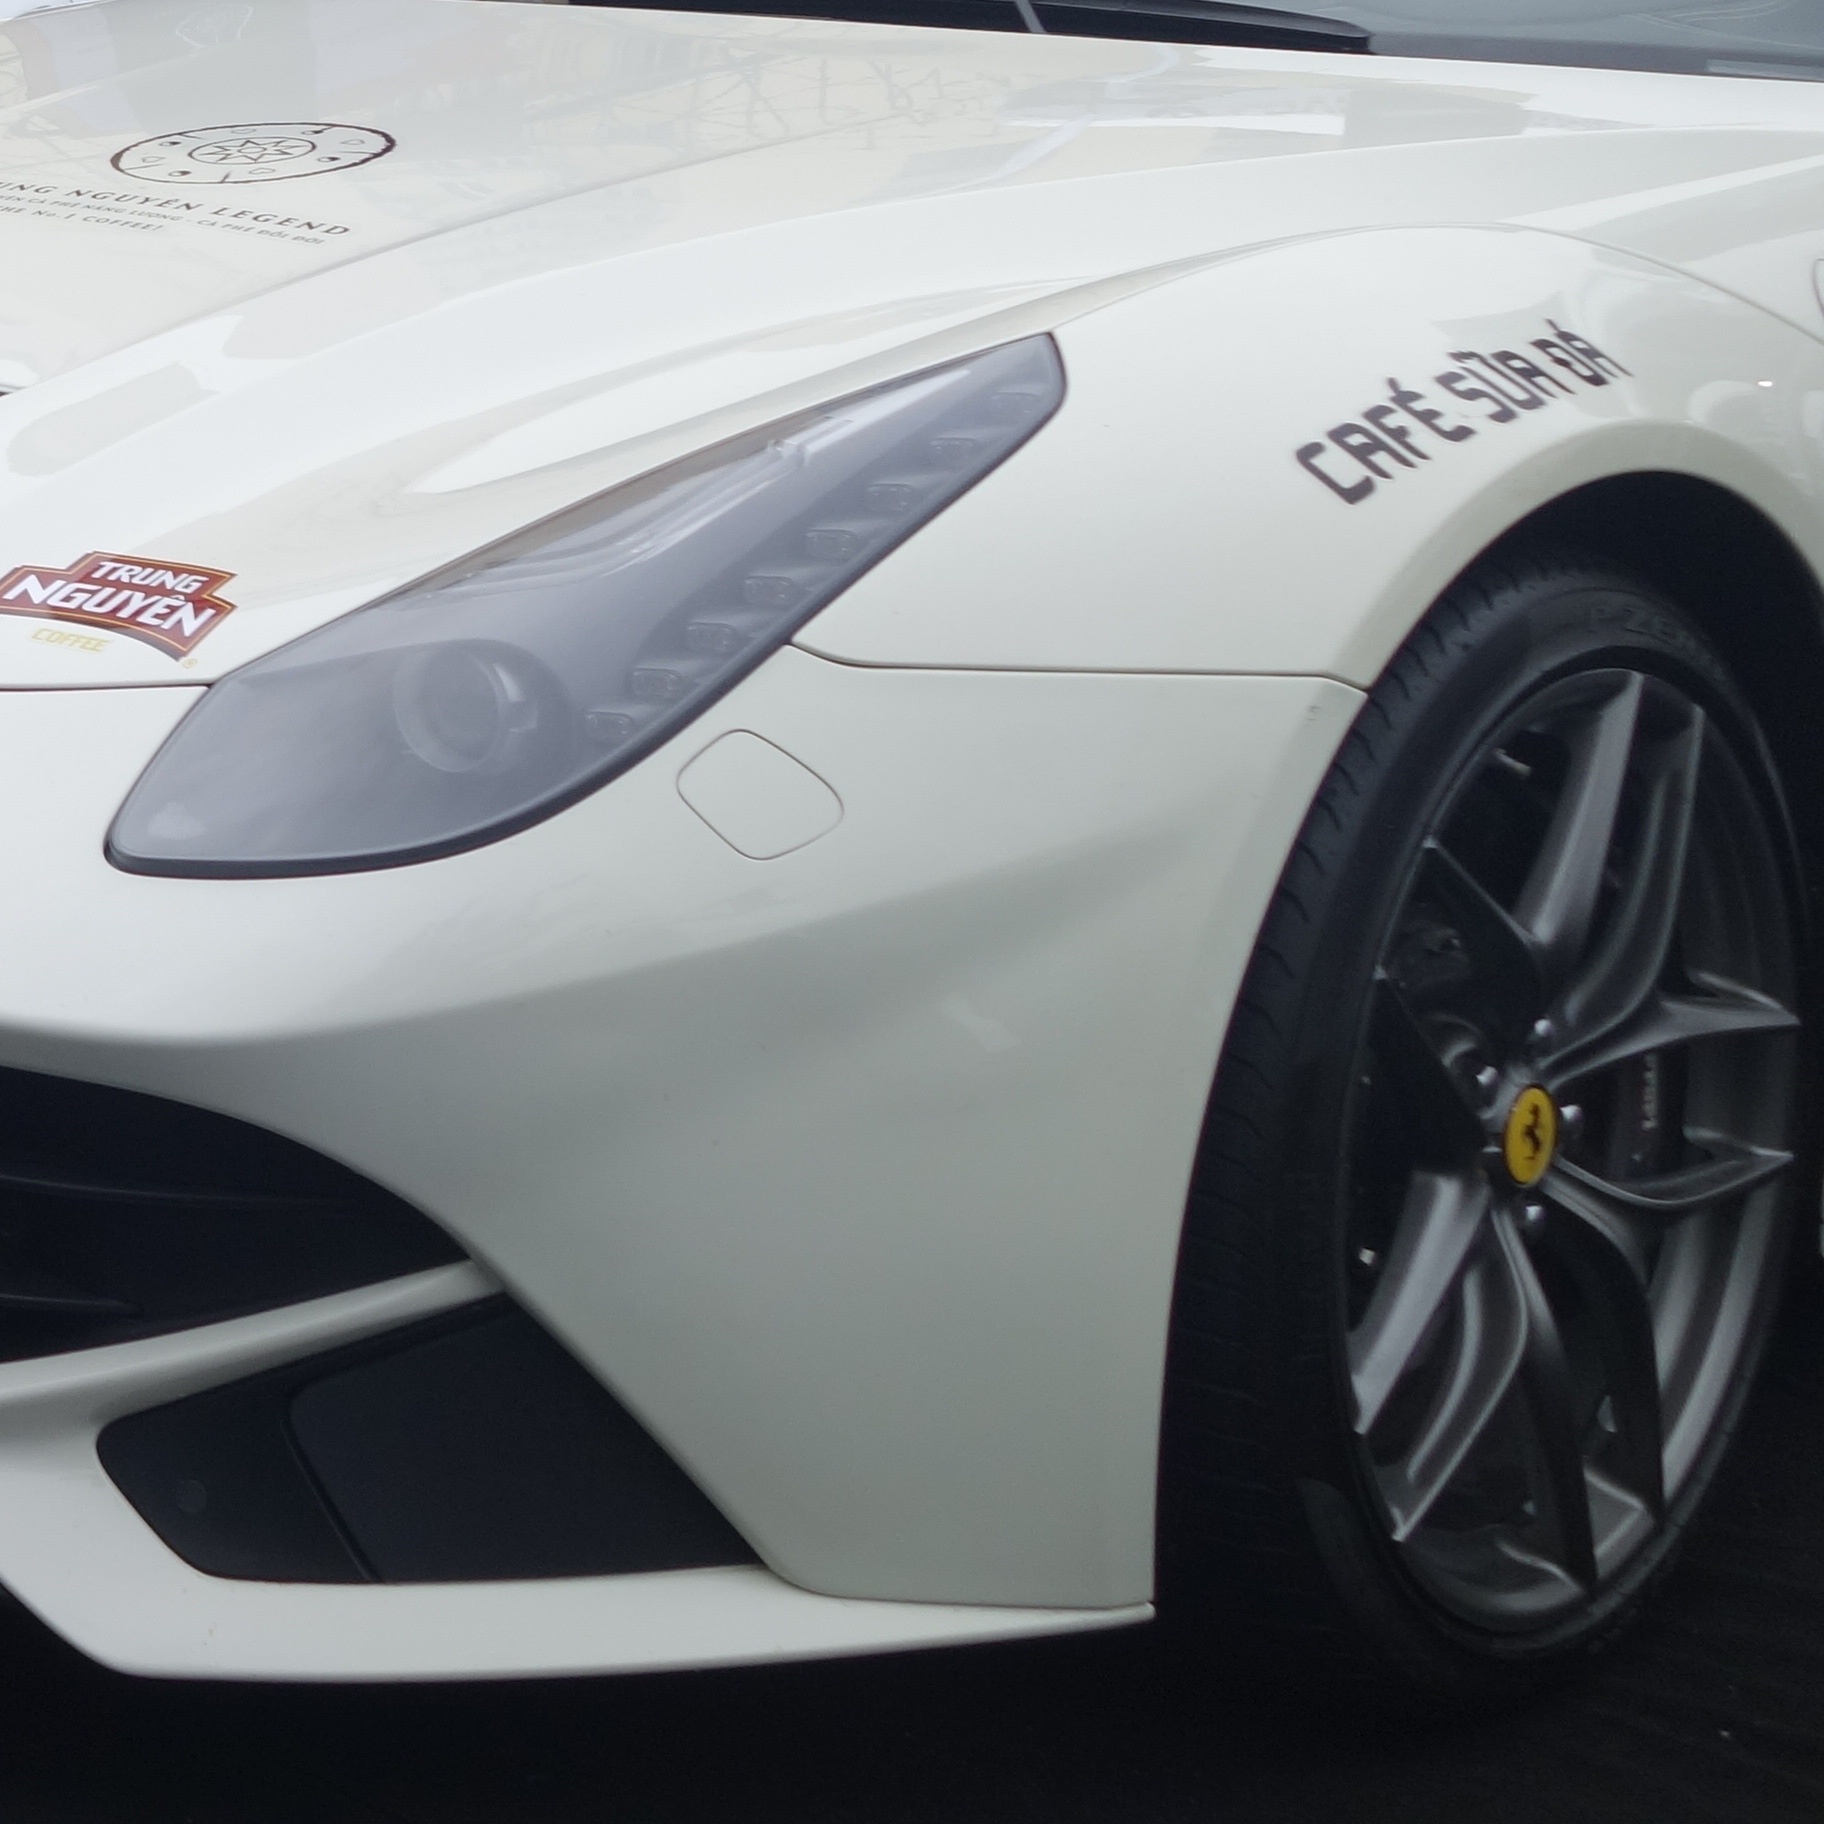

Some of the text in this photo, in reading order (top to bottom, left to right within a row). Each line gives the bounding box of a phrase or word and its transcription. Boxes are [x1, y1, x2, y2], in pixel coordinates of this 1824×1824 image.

[32, 210, 75, 220] No.1
[82, 214, 164, 232] COFFEE!
[64, 188, 204, 212] NGUYÊN
[210, 206, 351, 236] LEGEND
[1296, 318, 1635, 505] CAFÉ SỮA ĐÁ
[91, 561, 210, 594] TRUNG
[2, 574, 217, 637] NGUYÊN
[31, 628, 109, 652] COFFEE
